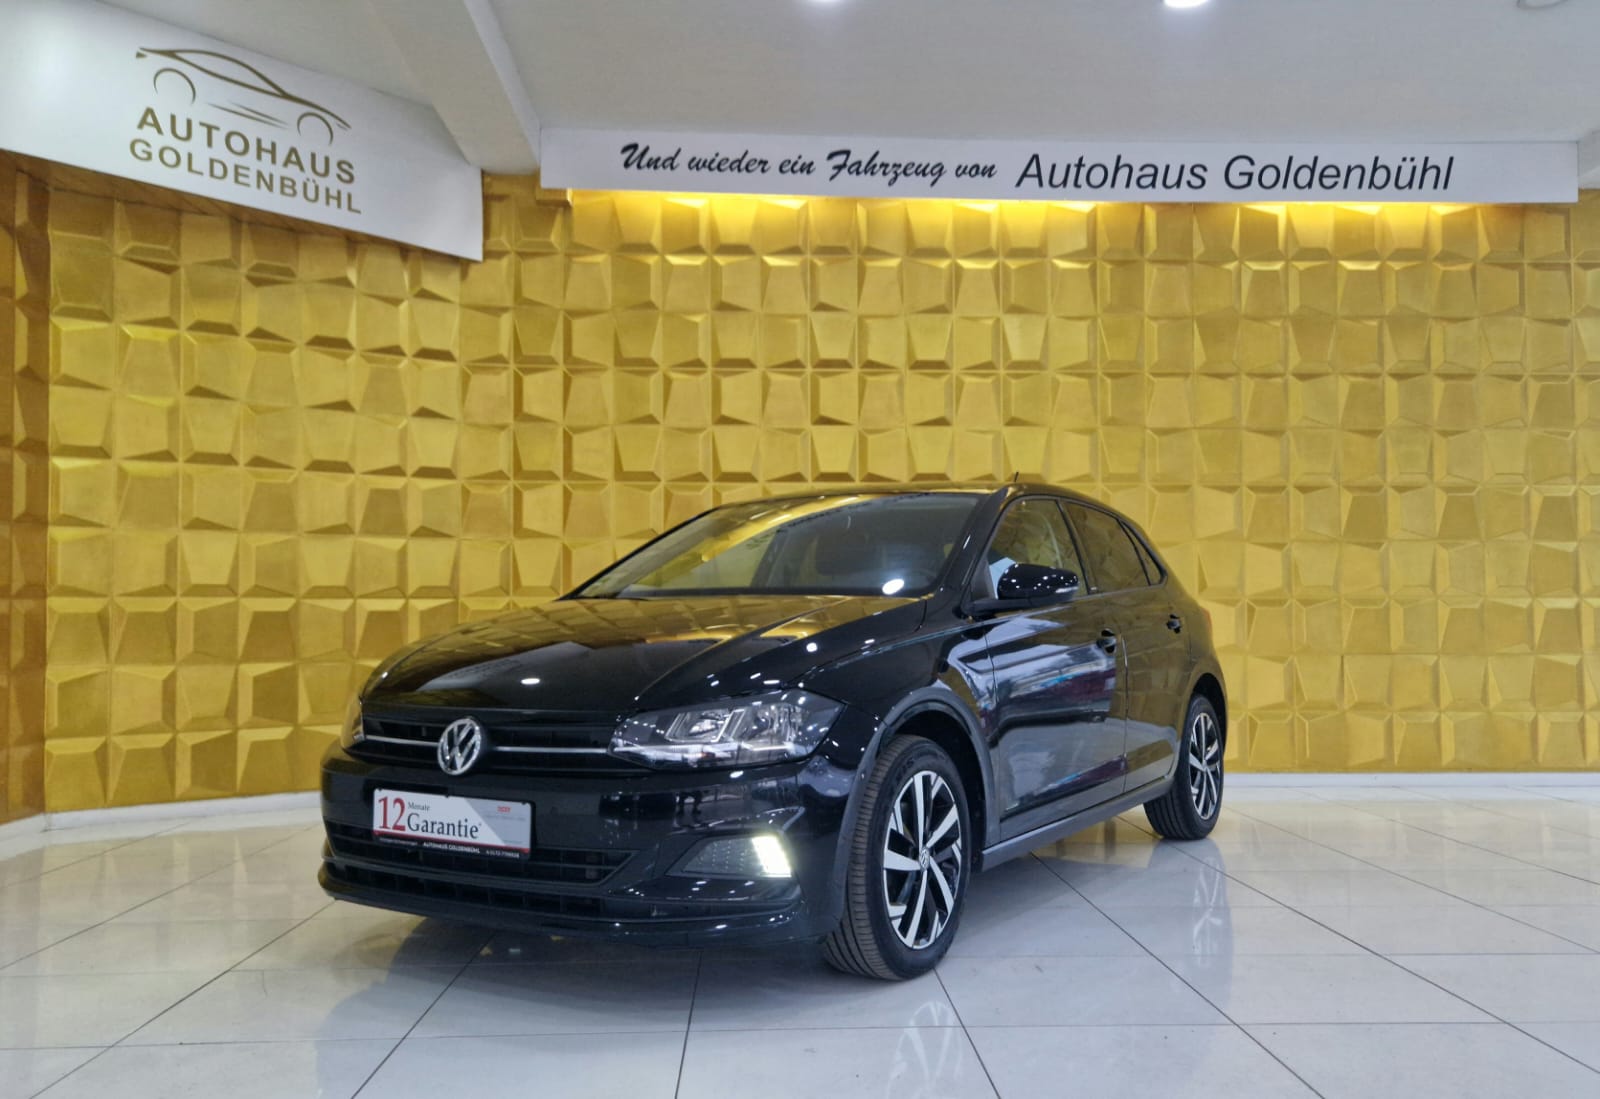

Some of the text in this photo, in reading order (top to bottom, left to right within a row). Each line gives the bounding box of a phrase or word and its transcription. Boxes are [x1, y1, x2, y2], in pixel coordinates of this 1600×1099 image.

[129, 138, 362, 215] GOLDENBÜHL
[137, 106, 355, 185] AUTOHAUS
[620, 142, 1455, 191] Und wieder ein Fahrzeug von Autohaus Goldenbühl
[378, 795, 406, 832] 12
